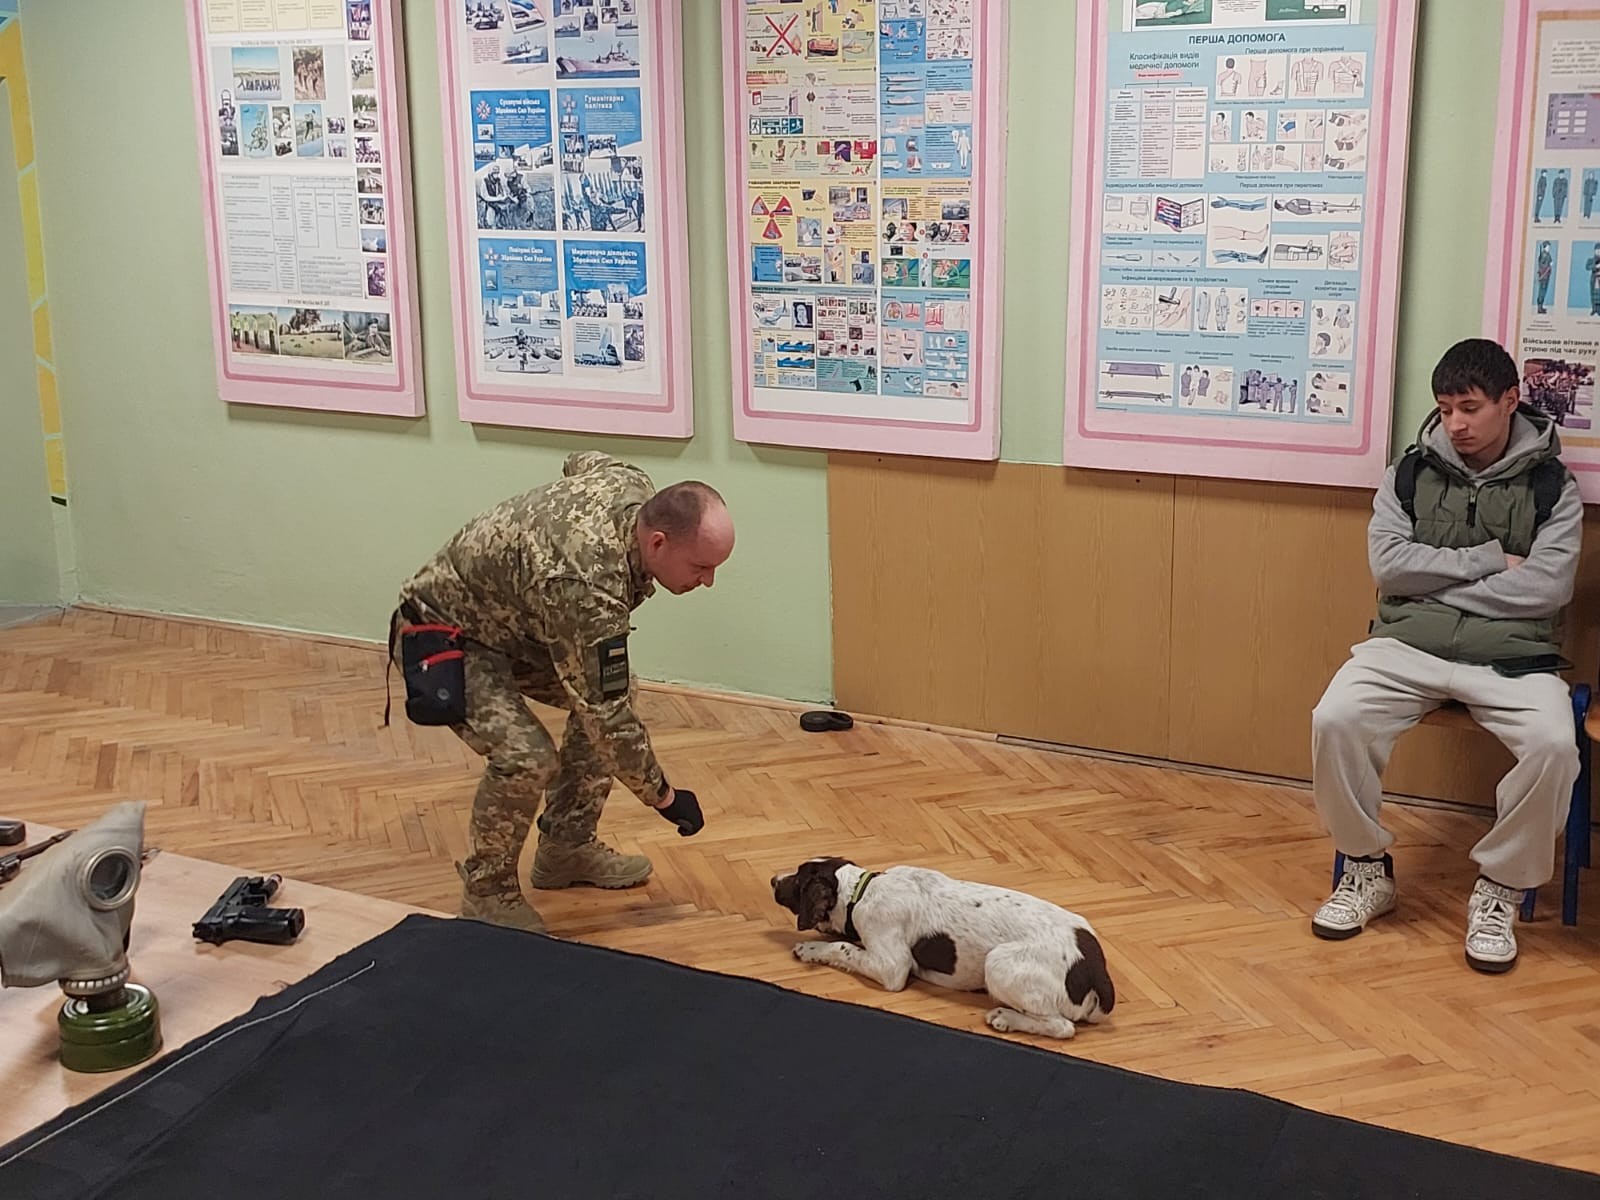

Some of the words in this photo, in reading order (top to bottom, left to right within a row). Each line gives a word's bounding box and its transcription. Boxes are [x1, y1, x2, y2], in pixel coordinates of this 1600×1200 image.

[1188, 34, 1225, 45] ПЕРША
[1227, 32, 1286, 44] ДОПОМОГА
[1267, 47, 1298, 55] допомога
[1300, 46, 1311, 54] при
[1129, 52, 1178, 61] Класифікація
[1180, 52, 1200, 60] видів
[1129, 62, 1162, 70] медичної
[1164, 61, 1200, 69] допомоги
[1578, 348, 1597, 356] руху
